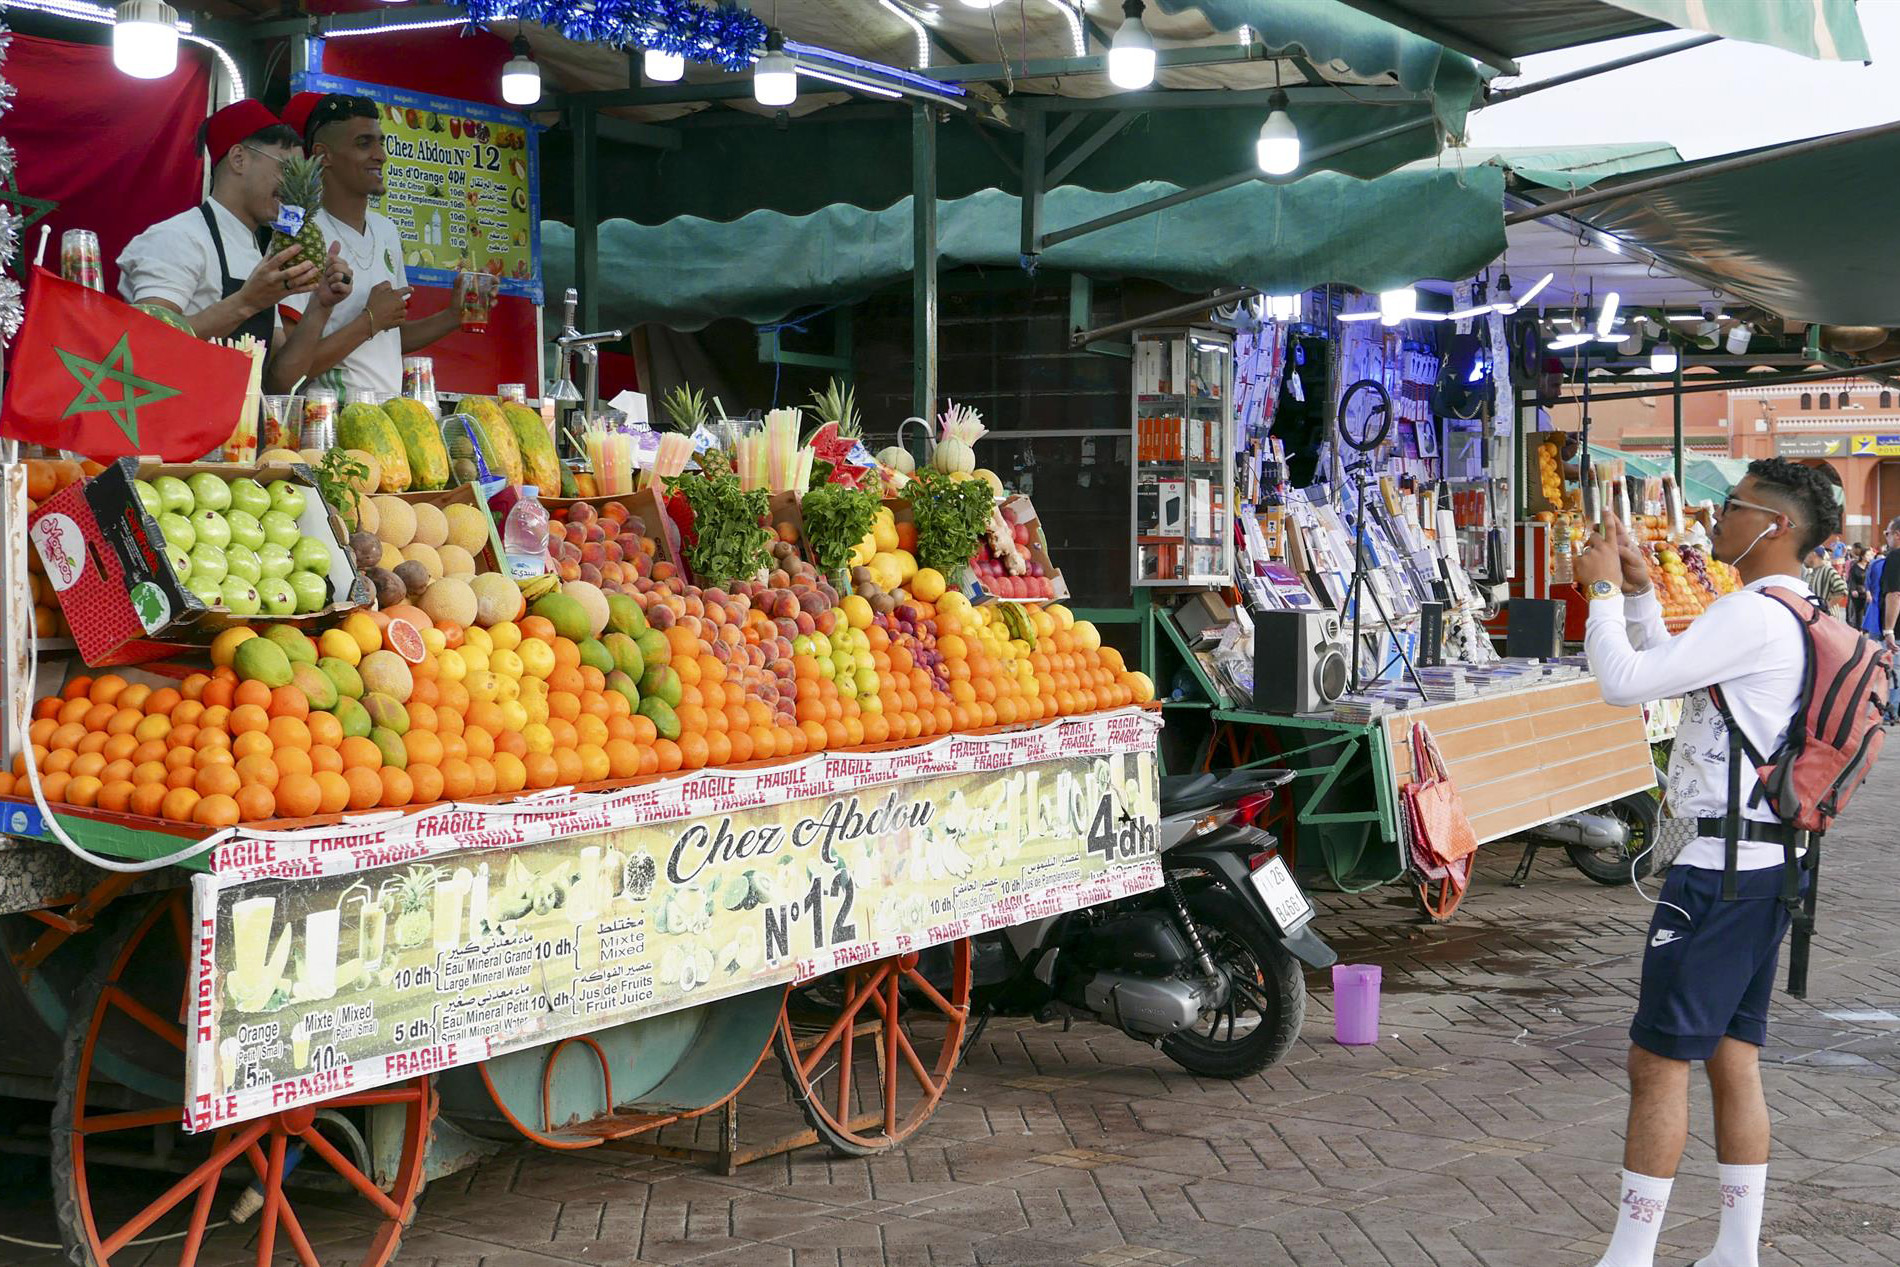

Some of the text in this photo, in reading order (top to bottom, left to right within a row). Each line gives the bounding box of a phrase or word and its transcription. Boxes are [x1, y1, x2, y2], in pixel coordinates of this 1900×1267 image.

[386, 135, 414, 159] Chez
[417, 141, 451, 165] Abdou
[472, 144, 500, 172] 12
[388, 164, 466, 185] Jus d'Orange 4DH
[388, 179, 465, 198] Jus de Citron 10dh
[388, 192, 465, 210] Jus de Pamplemousse 10dh
[400, 218, 415, 228] Petit
[450, 225, 458, 233] 05
[458, 226, 466, 234] dh
[450, 212, 466, 222] 10dh
[401, 232, 466, 247] Grand 10 dh
[973, 752, 1014, 769] FRAGILE
[1108, 728, 1144, 746] FRAGILE
[415, 812, 487, 838] FRAGILE
[682, 776, 736, 802] FRAGILE
[825, 759, 872, 780] FRAGILE
[667, 792, 936, 885] Chez Abdou
[1087, 793, 1155, 862] 4dh
[1001, 879, 1020, 895] 10 dh
[1024, 897, 1063, 920] FRAGILE
[1075, 887, 1113, 908] FRAGILE
[1122, 873, 1156, 895] FRAGILE
[930, 900, 940, 914] 10
[941, 897, 951, 912] dh
[447, 942, 480, 960] كبير
[535, 938, 571, 960] 10 dh
[600, 931, 645, 949] Mixte
[600, 942, 645, 961] Mixed
[833, 942, 881, 968] FRAGILE
[927, 919, 971, 945] FRAGILE
[445, 947, 532, 977] Eau Mineral Grand
[197, 918, 214, 1044] FRAGILE
[395, 965, 432, 990] 10 dh
[443, 963, 532, 991] Large Mineral Water
[579, 976, 653, 1002] Jus de Fruits
[531, 992, 569, 1011] 10 dh
[586, 989, 653, 1014] Fruit Juice
[305, 1013, 333, 1033] Mixte
[342, 1002, 372, 1025] Mixed
[442, 1000, 529, 1030] Eau Mineral Petit
[238, 1024, 279, 1045] Orange
[394, 1019, 429, 1042] 5 dh
[441, 1031, 467, 1043] Small
[469, 1022, 502, 1038] Mineral
[272, 1064, 355, 1108] FRAGILE
[384, 1043, 458, 1080] FRAGILE
[1629, 1205, 1655, 1224] 23
